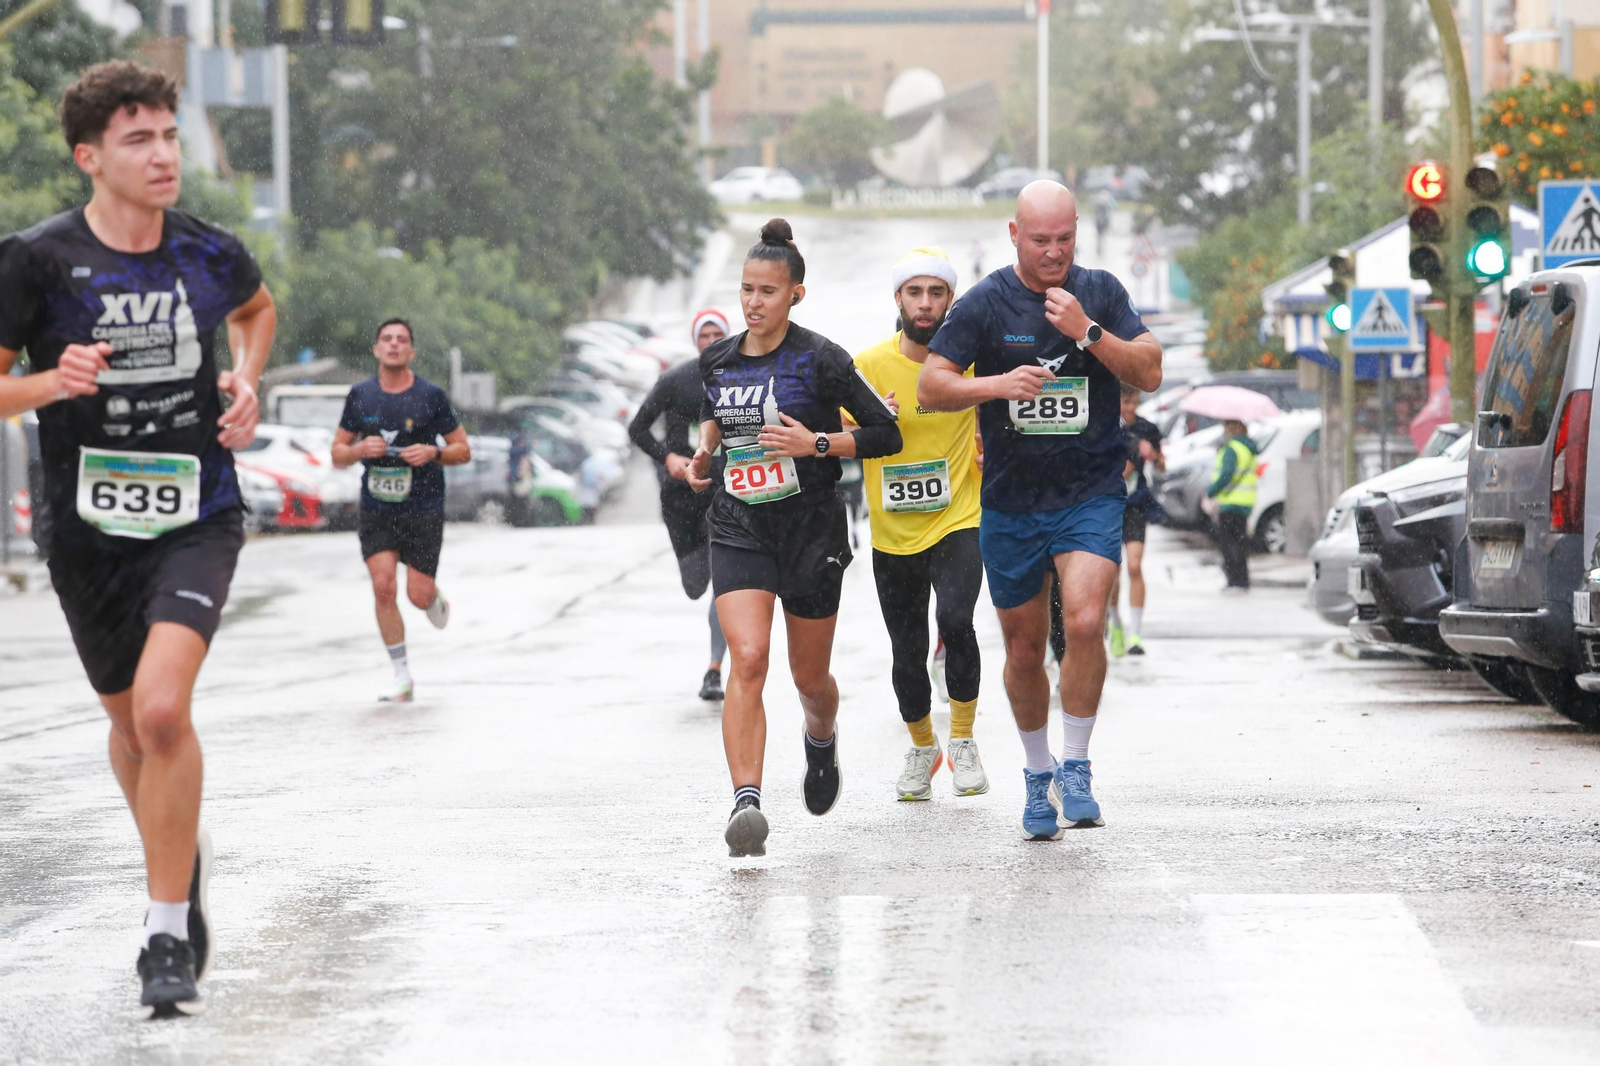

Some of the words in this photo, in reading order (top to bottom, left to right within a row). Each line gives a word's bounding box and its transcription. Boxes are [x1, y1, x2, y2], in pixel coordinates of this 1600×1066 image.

[97, 291, 173, 325] XVI
[715, 385, 765, 407] XVI
[1017, 396, 1079, 419] 289
[714, 408, 744, 417] CARRERA
[745, 407, 761, 416] DEL
[721, 415, 762, 425] ESTRECHO
[373, 478, 405, 492] 246
[729, 461, 785, 491] 201
[92, 481, 181, 514] 639
[888, 477, 943, 502] 390
